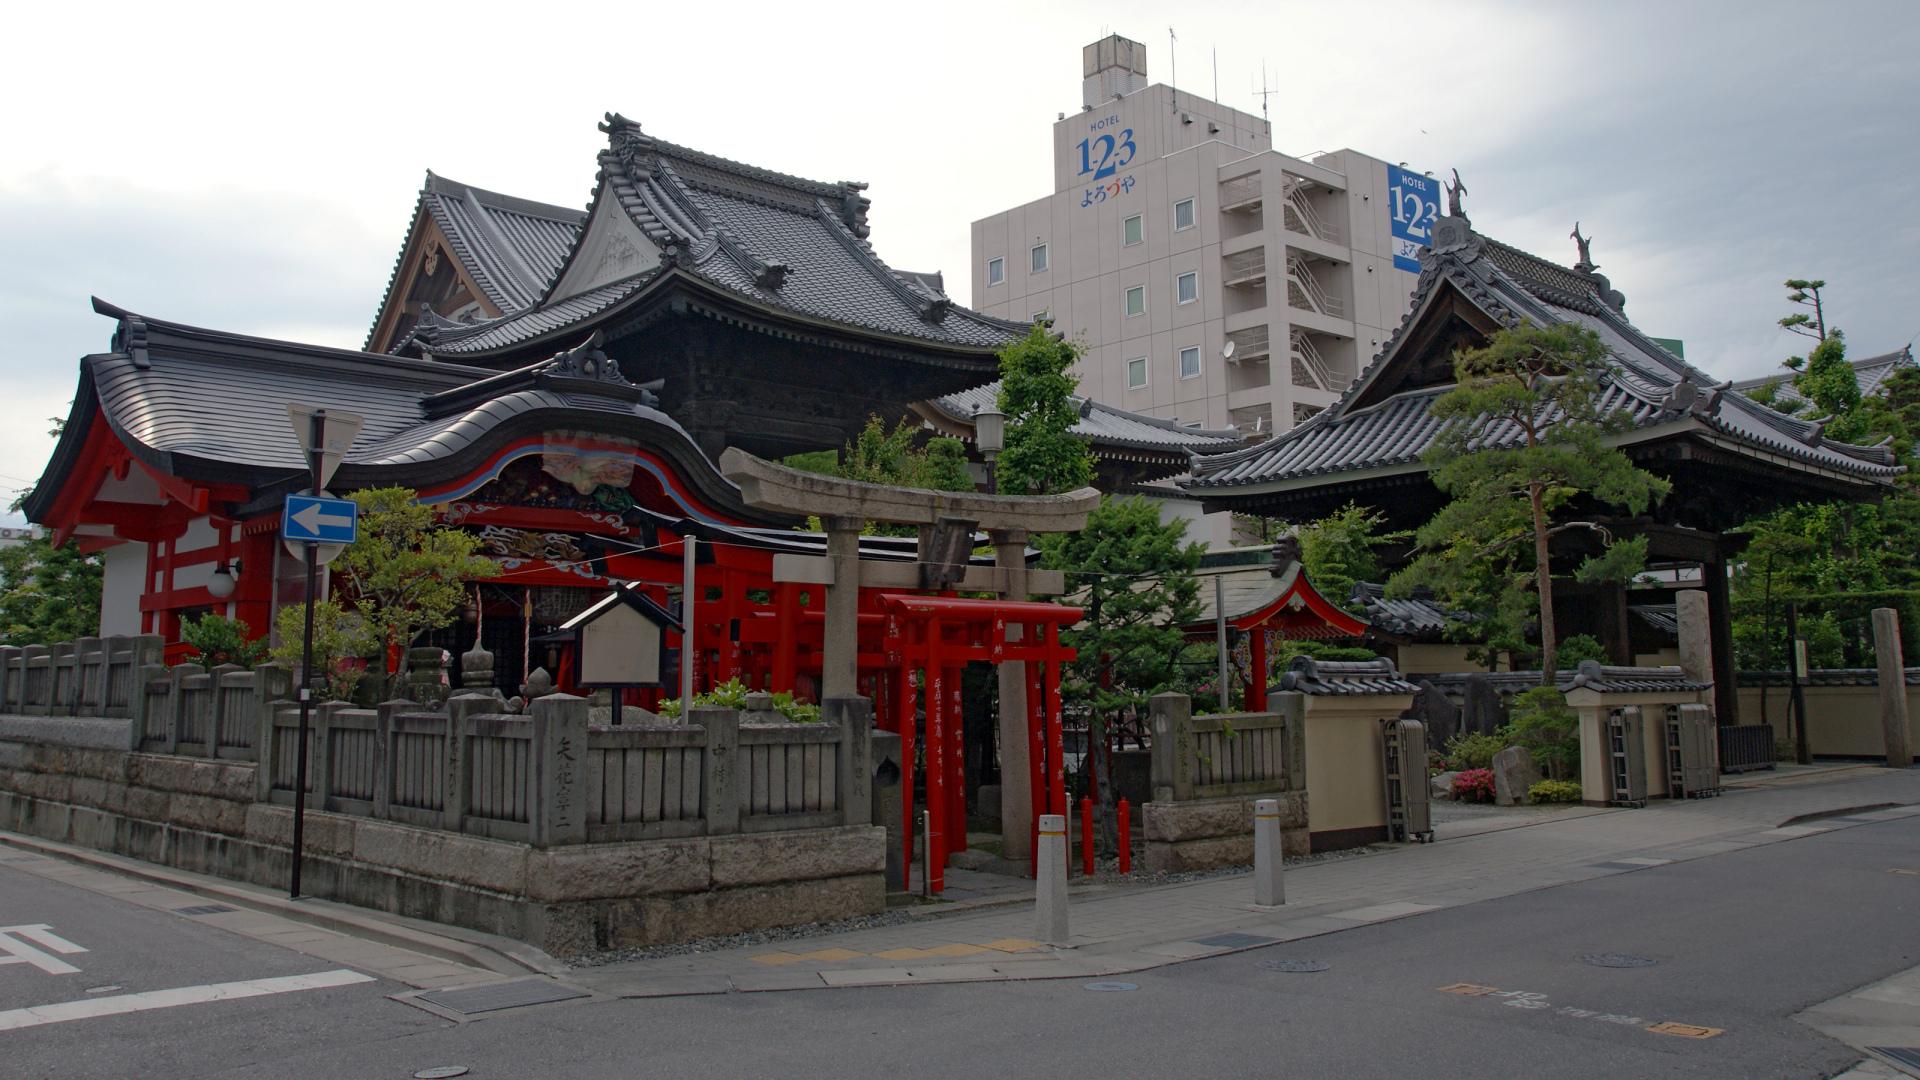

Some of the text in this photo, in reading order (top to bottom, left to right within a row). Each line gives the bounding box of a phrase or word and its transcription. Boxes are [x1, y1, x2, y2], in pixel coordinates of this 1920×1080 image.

[1091, 114, 1120, 132] HOTEL
[1076, 128, 1136, 181] 1-2-3
[1081, 175, 1135, 207] よろづや
[1402, 175, 1426, 191] HOTEL
